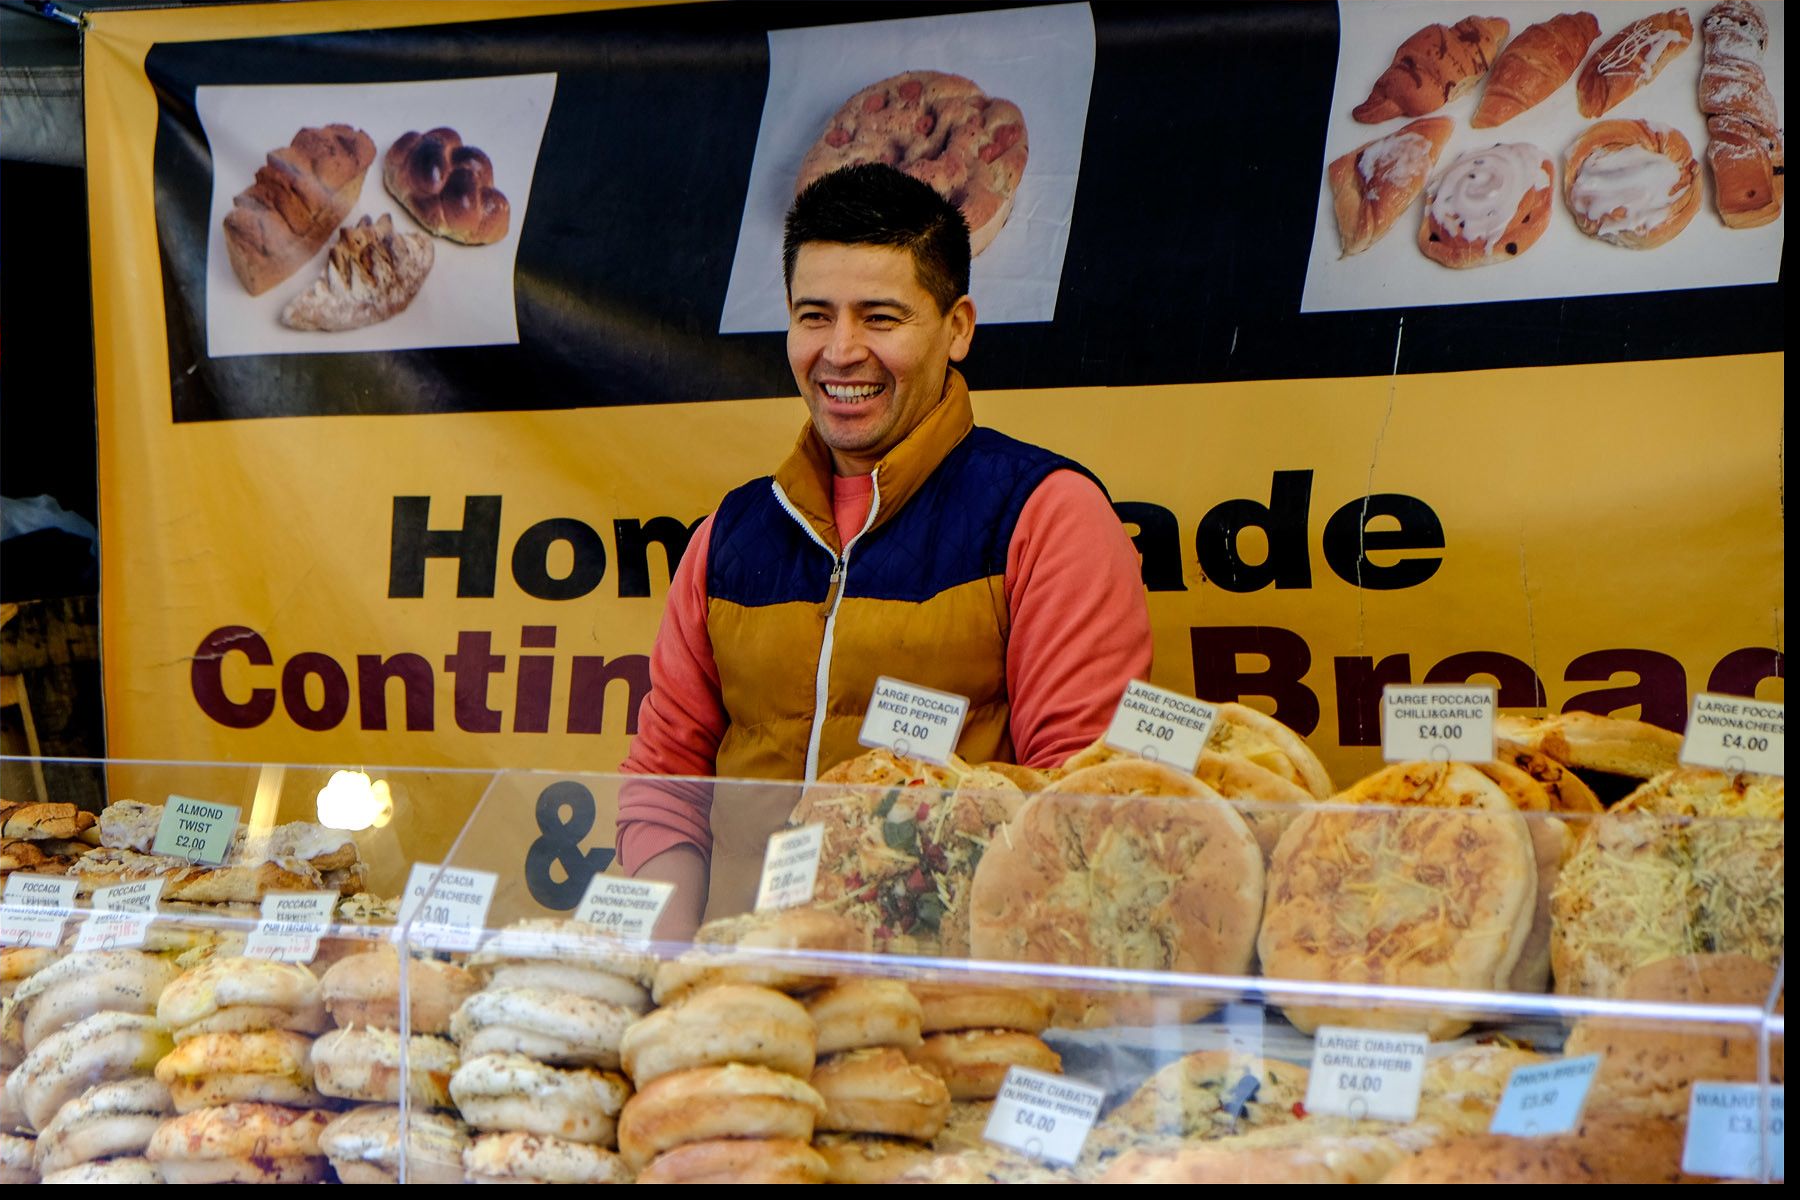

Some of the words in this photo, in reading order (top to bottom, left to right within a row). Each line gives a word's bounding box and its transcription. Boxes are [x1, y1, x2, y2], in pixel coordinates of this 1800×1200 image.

[876, 686, 910, 702] LARGE
[911, 692, 960, 716] FOCCACIA
[1127, 685, 1162, 704] LARGE
[1162, 695, 1213, 720] FOCCACIA
[1388, 693, 1428, 706] LARGE
[1430, 694, 1492, 707] FOCCACIA
[1696, 701, 1738, 716] LARGE
[877, 700, 907, 715] MIXED
[908, 707, 948, 726] PEPPER
[1123, 699, 1206, 732] GARLIC&CHEESE
[1395, 708, 1483, 720] CHILLI&GARLIC
[892, 720, 929, 740] £4.00
[1135, 718, 1175, 742] £4.00
[1418, 725, 1463, 740] £4.00
[1721, 733, 1769, 752] £4.00
[175, 802, 223, 820] ALMOND
[179, 818, 212, 834] TWIST
[175, 836, 206, 850] £2.00
[524, 780, 616, 911] &
[22, 882, 61, 894] FOCCACIA
[429, 873, 474, 888] FCCACIA
[606, 883, 650, 897] FOCCACIA
[108, 883, 146, 898] FOCCACIA
[414, 885, 484, 906] OLE&CHEESE
[277, 899, 318, 910] FOCCACIA
[589, 909, 623, 926] £2.00
[1319, 1037, 1360, 1050] LARGE
[1364, 1039, 1425, 1056] CIABATTA
[1323, 1053, 1412, 1073] GARLIC&HERB
[1008, 1075, 1044, 1092] LARGE
[1047, 1084, 1100, 1107] CIABATTA
[1338, 1072, 1382, 1093] £4.00
[1056, 1101, 1093, 1120] PEPPER
[1015, 1108, 1056, 1133] £4.00
